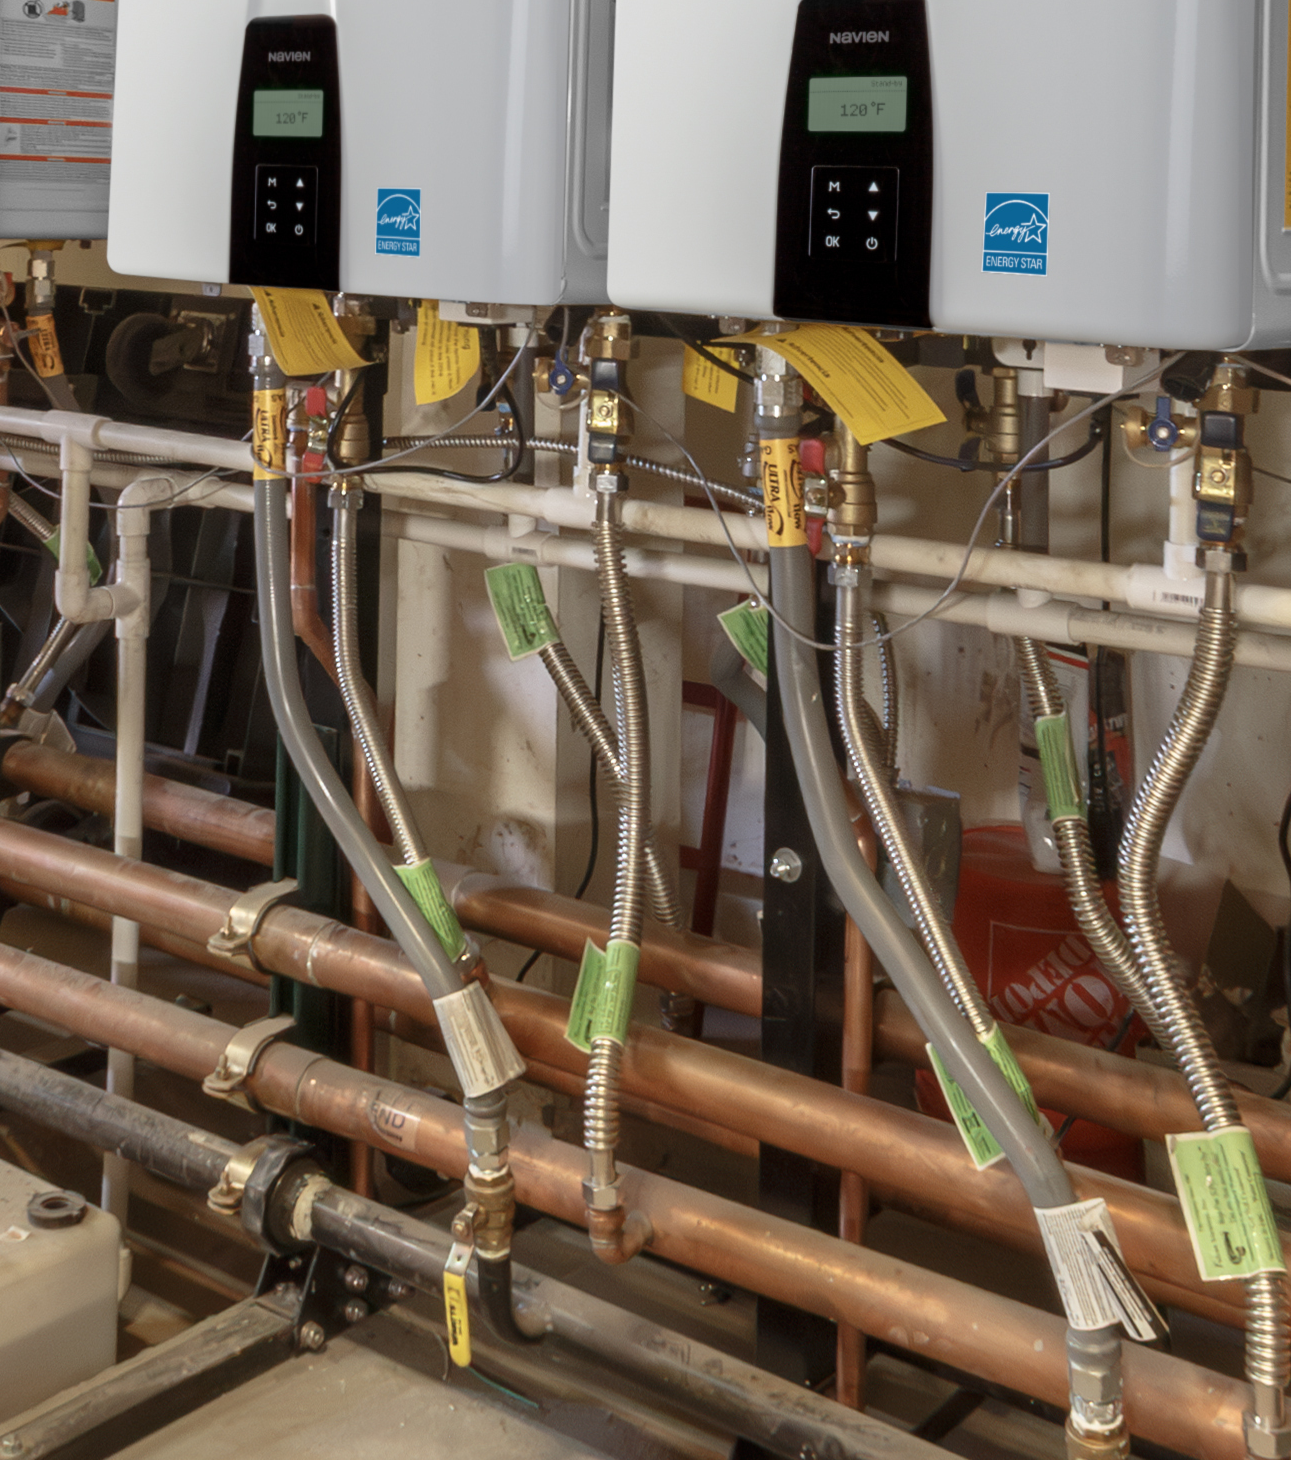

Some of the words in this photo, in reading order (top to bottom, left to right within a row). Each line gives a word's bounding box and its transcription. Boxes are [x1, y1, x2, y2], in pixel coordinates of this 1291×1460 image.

[828, 182, 840, 192] M
[986, 222, 1028, 241] energy
[377, 240, 401, 253] ENERGY
[402, 241, 418, 253] STAR
[825, 235, 840, 249] OK
[985, 256, 1019, 270] ENERGY
[1020, 257, 1043, 271] STAR
[768, 463, 781, 504] ULTRA
